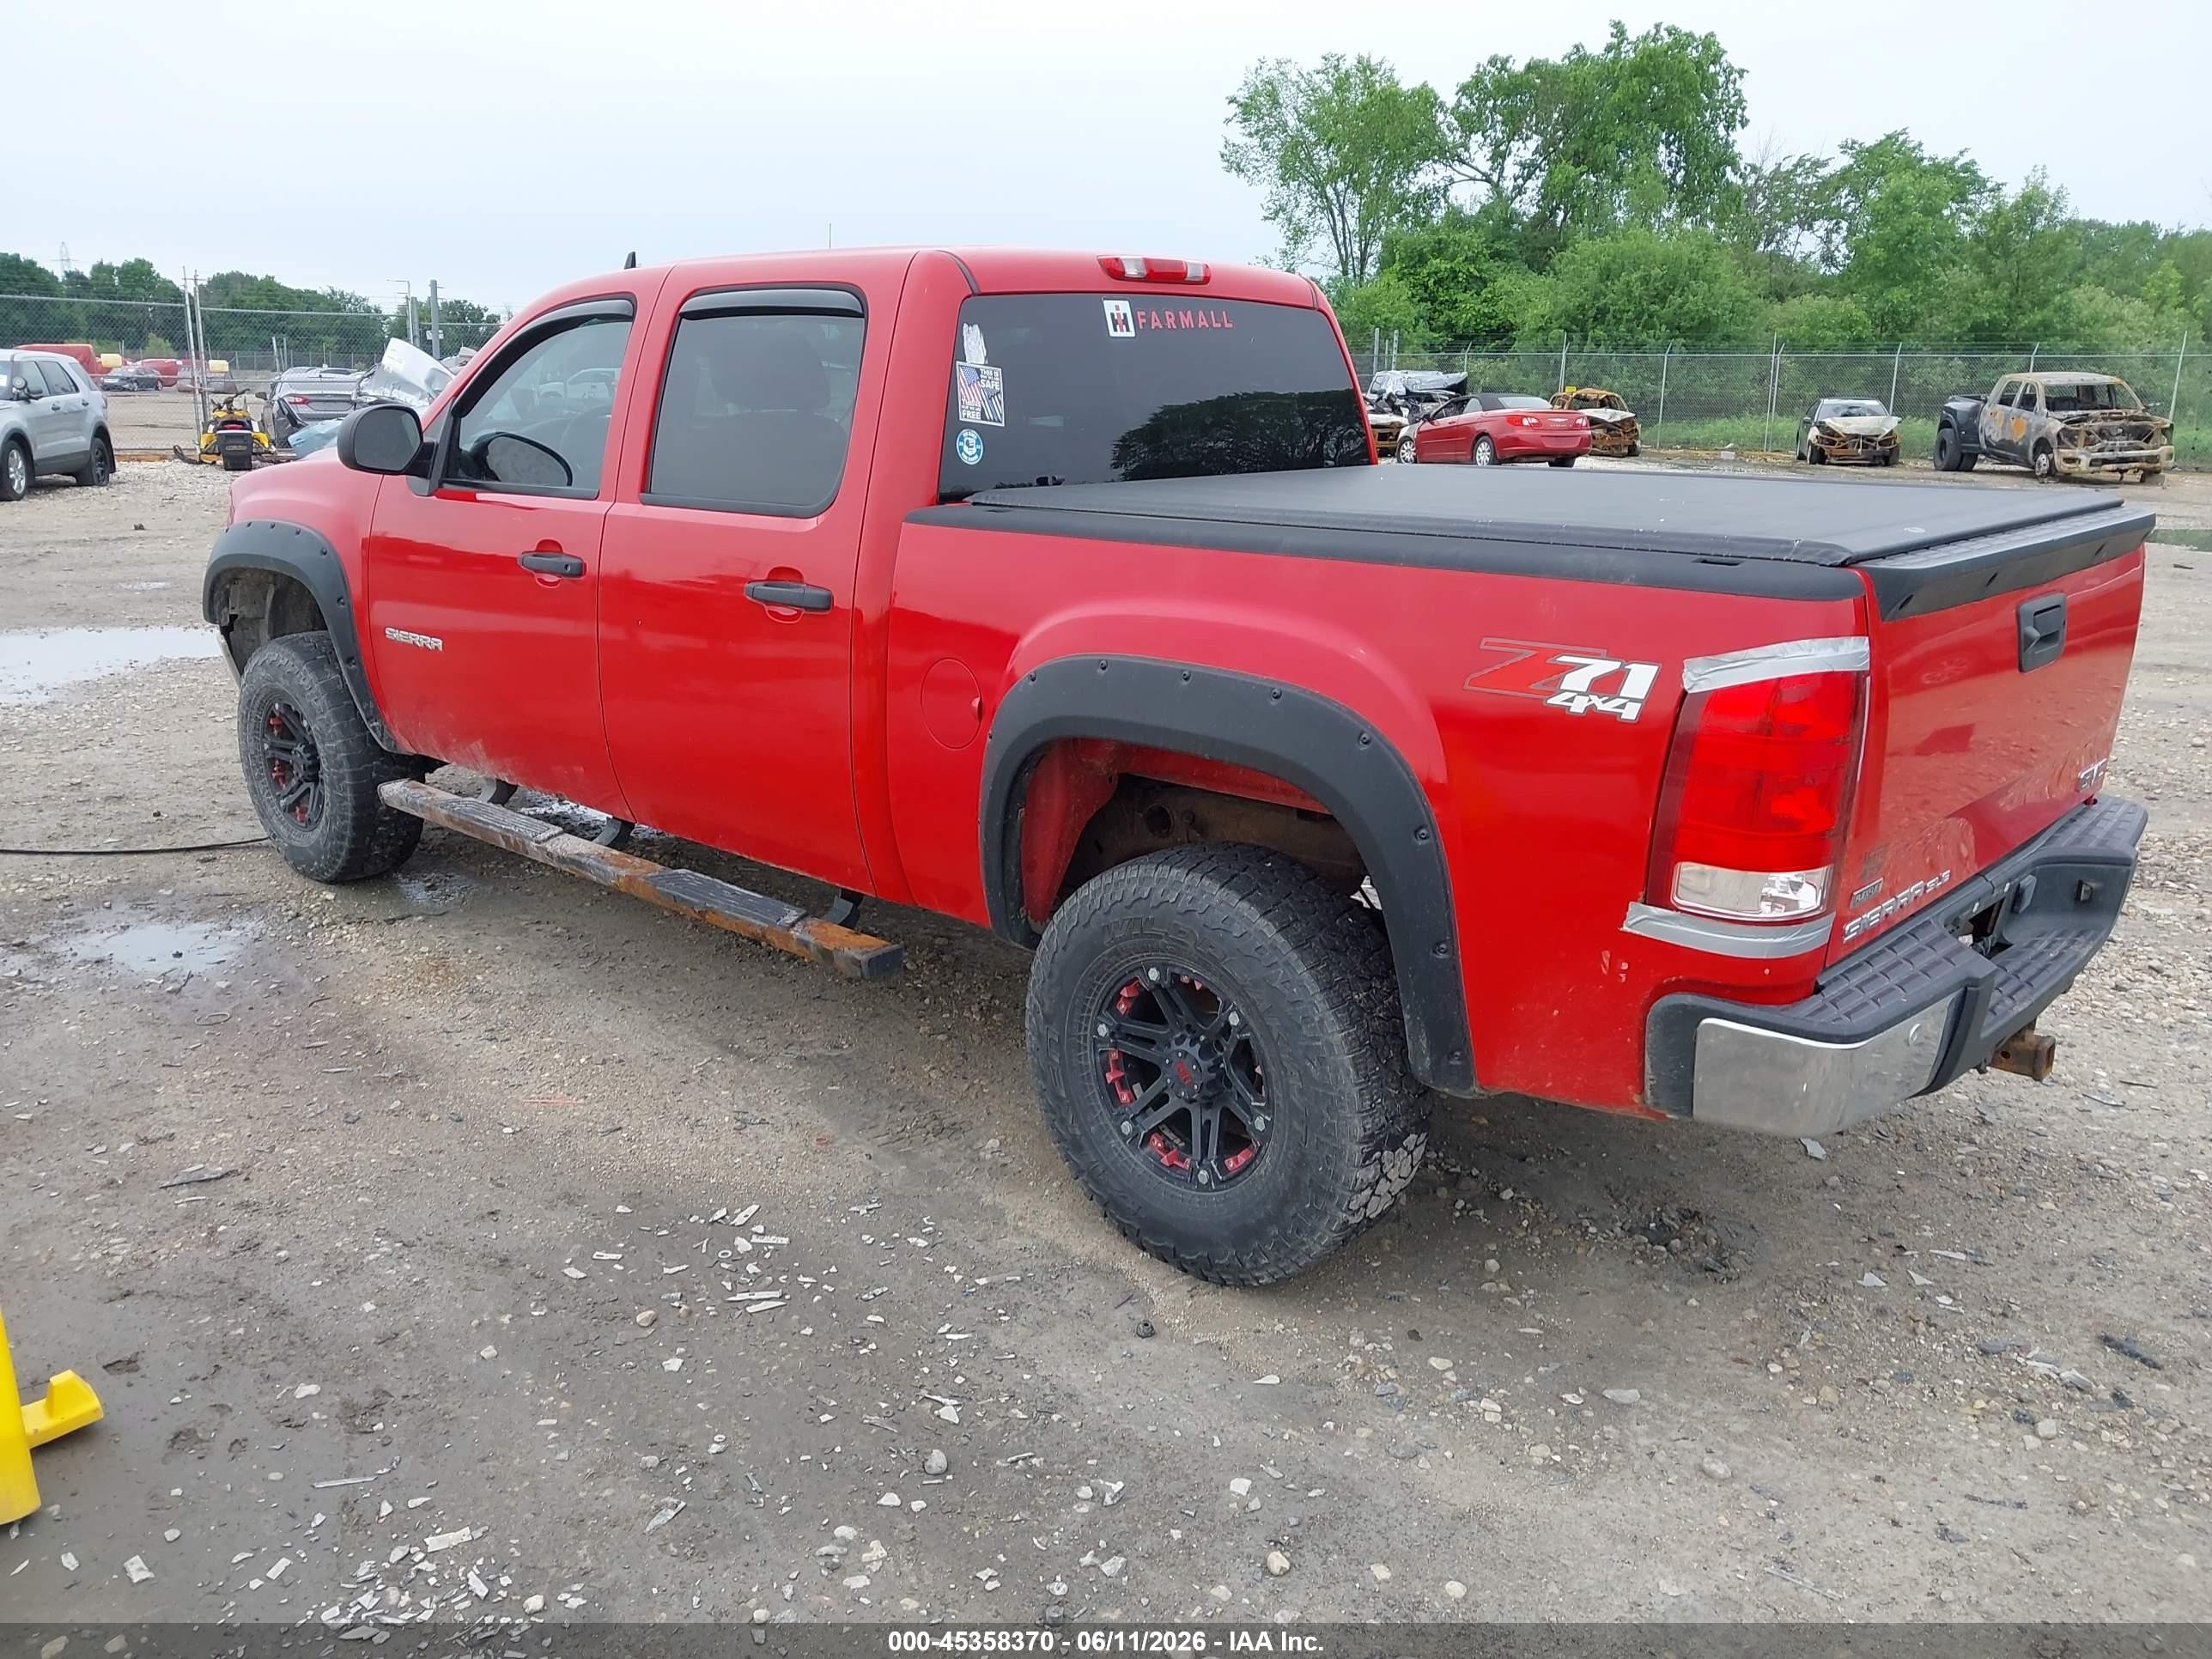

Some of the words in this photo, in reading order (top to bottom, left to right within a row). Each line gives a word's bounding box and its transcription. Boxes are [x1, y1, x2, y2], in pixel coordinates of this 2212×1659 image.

[1136, 309, 1234, 330] FARMALL
[981, 379, 1000, 390] SAFE
[962, 410, 981, 420] FREE
[385, 627, 443, 652] SIERRA
[1462, 637, 1662, 701] Z71
[1843, 880, 1924, 943] SIERRA
[1925, 869, 1950, 894] SLE
